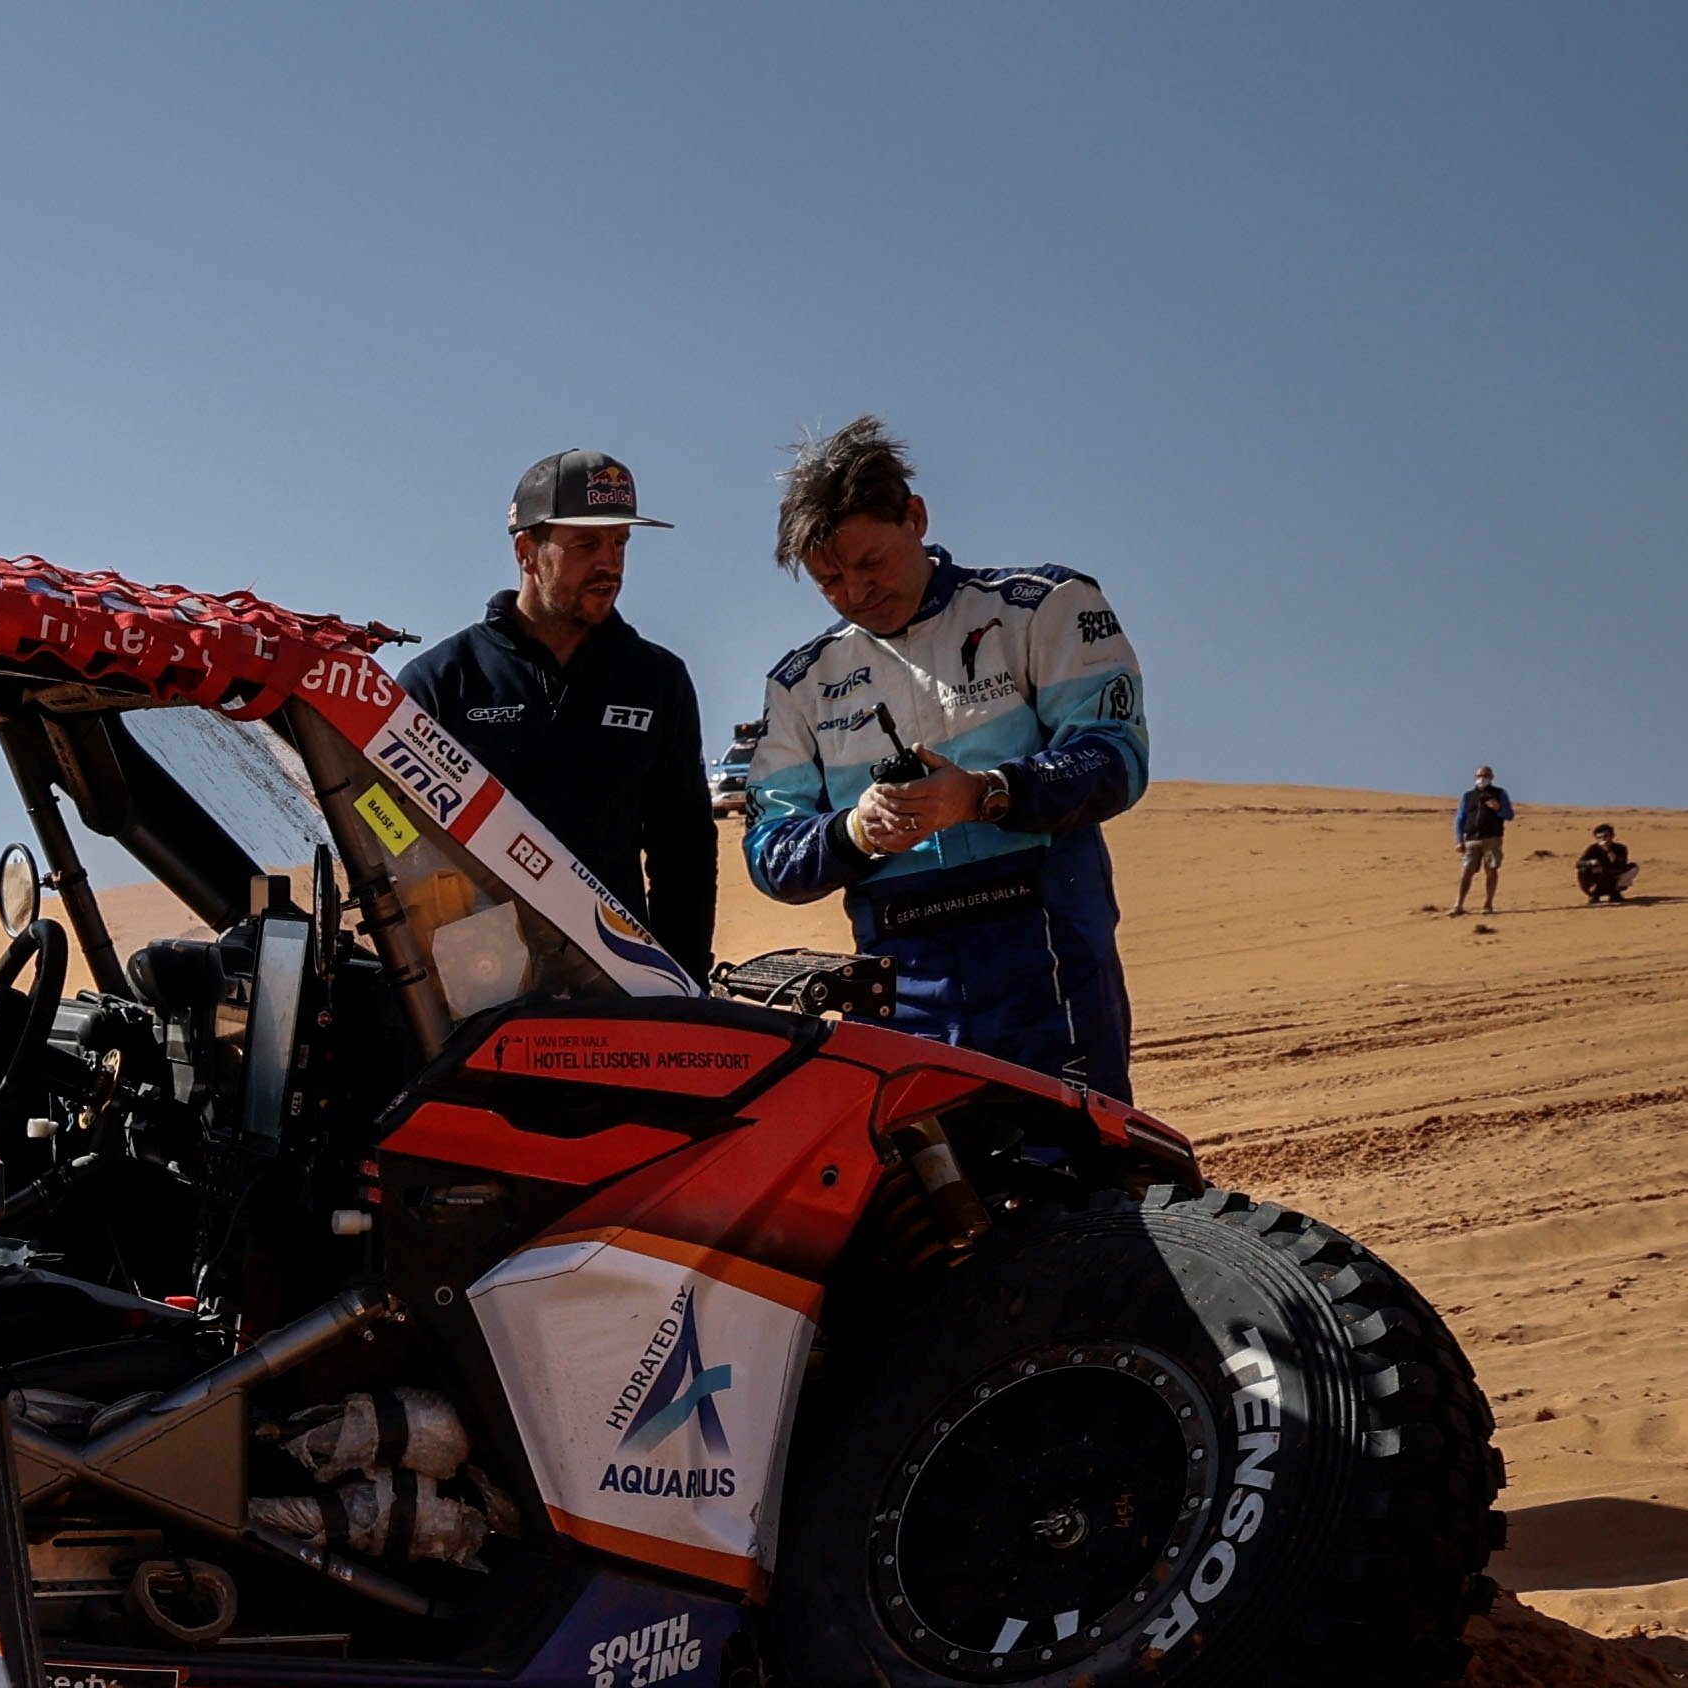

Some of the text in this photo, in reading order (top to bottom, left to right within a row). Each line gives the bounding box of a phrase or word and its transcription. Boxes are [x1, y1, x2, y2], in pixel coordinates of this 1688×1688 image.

[587, 489, 616, 505] Red
[969, 680, 992, 695] DER
[403, 727, 429, 752] SPORT
[434, 756, 463, 783] CASINO
[413, 712, 474, 775] Circus
[366, 797, 395, 833] BALISE
[510, 839, 547, 876] RB
[570, 859, 655, 945] LUBRICANTS
[896, 908, 922, 924] GERT
[944, 898, 966, 912] VAN
[968, 892, 990, 906] DER
[991, 886, 1017, 901] VALK
[534, 1052, 751, 1070] HOTEL LEUSDEN AMERSFOORT
[605, 1284, 688, 1432] HYDRATED BY
[599, 1463, 736, 1498] AQUARIUS
[1141, 1326, 1282, 1653] TENSOR
[587, 1612, 690, 1676] SOUTH
